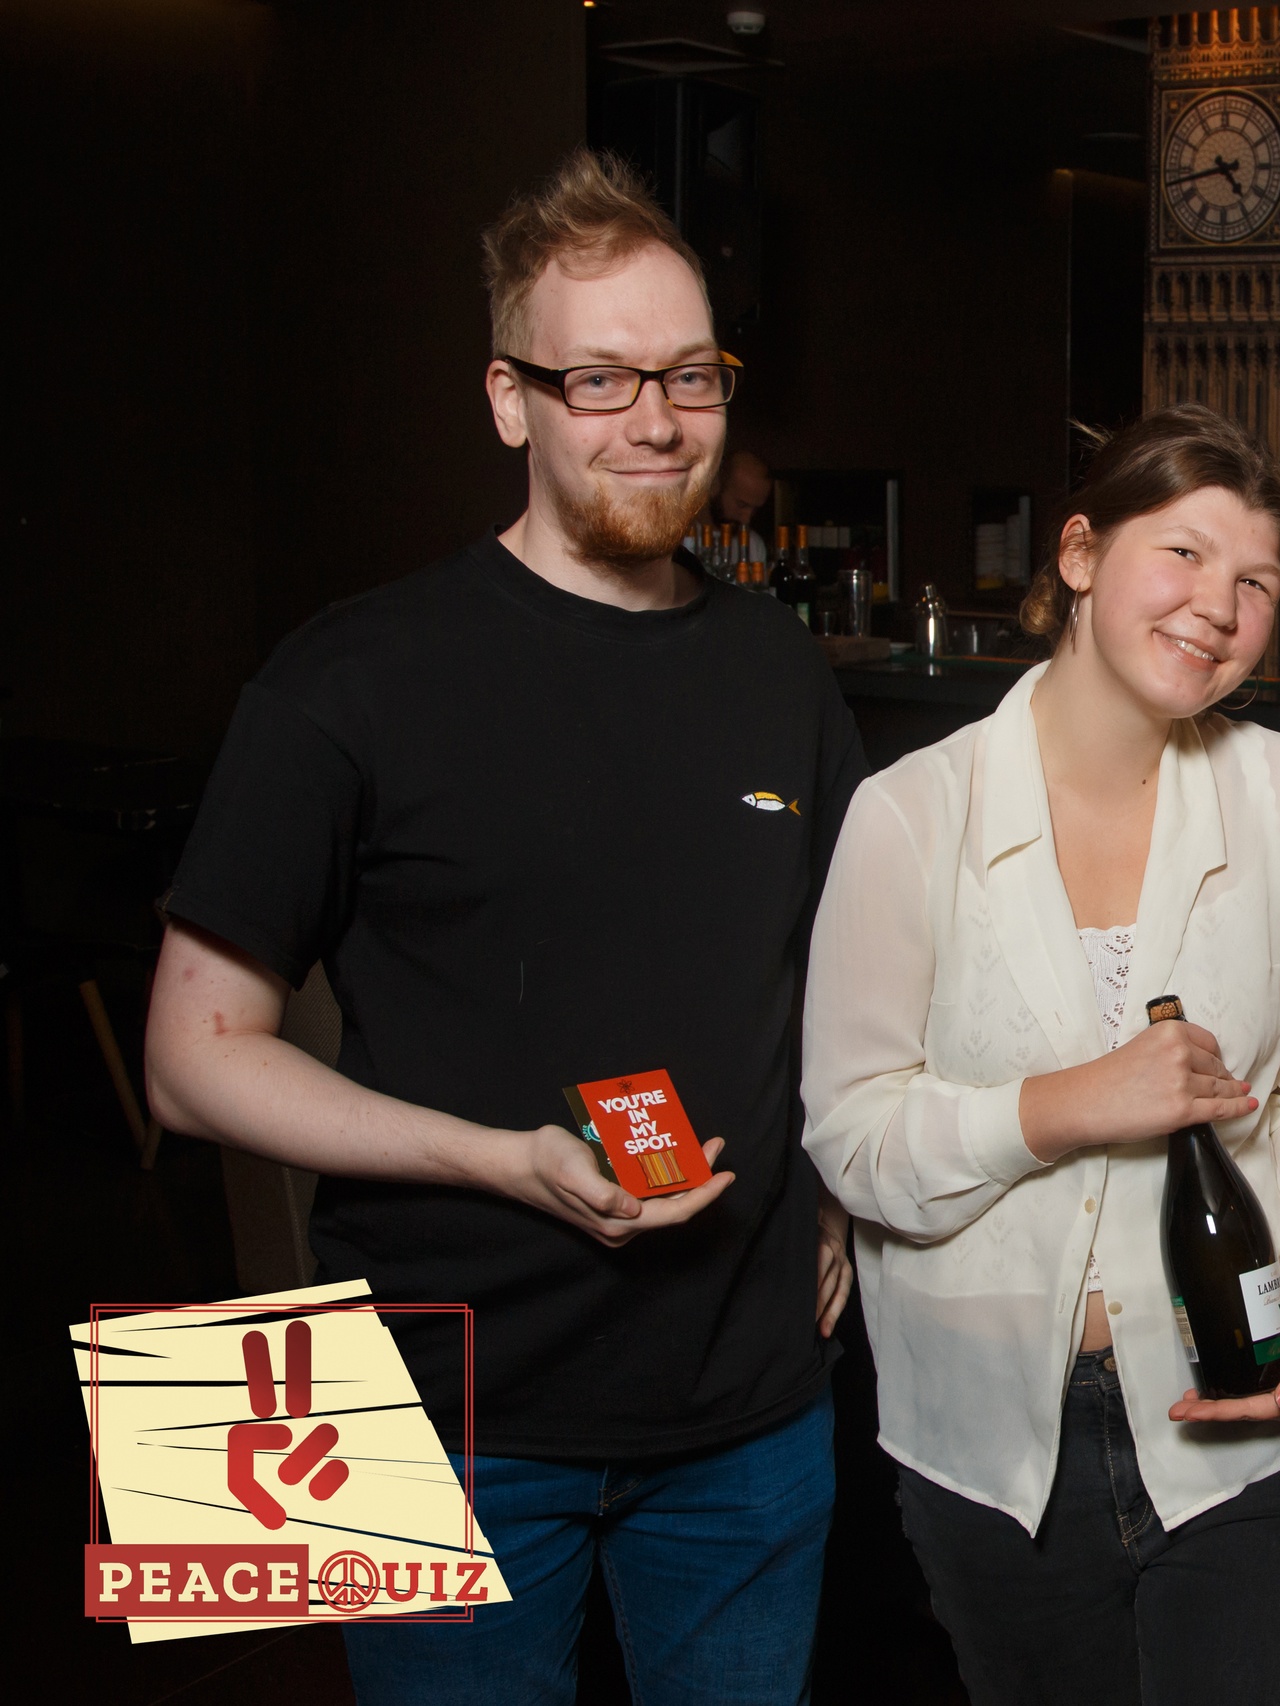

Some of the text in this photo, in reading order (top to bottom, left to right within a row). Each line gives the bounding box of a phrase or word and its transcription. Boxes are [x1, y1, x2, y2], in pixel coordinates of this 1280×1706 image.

[598, 1089, 667, 1113] YOU'RE
[627, 1108, 650, 1123] IN
[629, 1120, 657, 1138] MY
[624, 1132, 678, 1155] SPOT.
